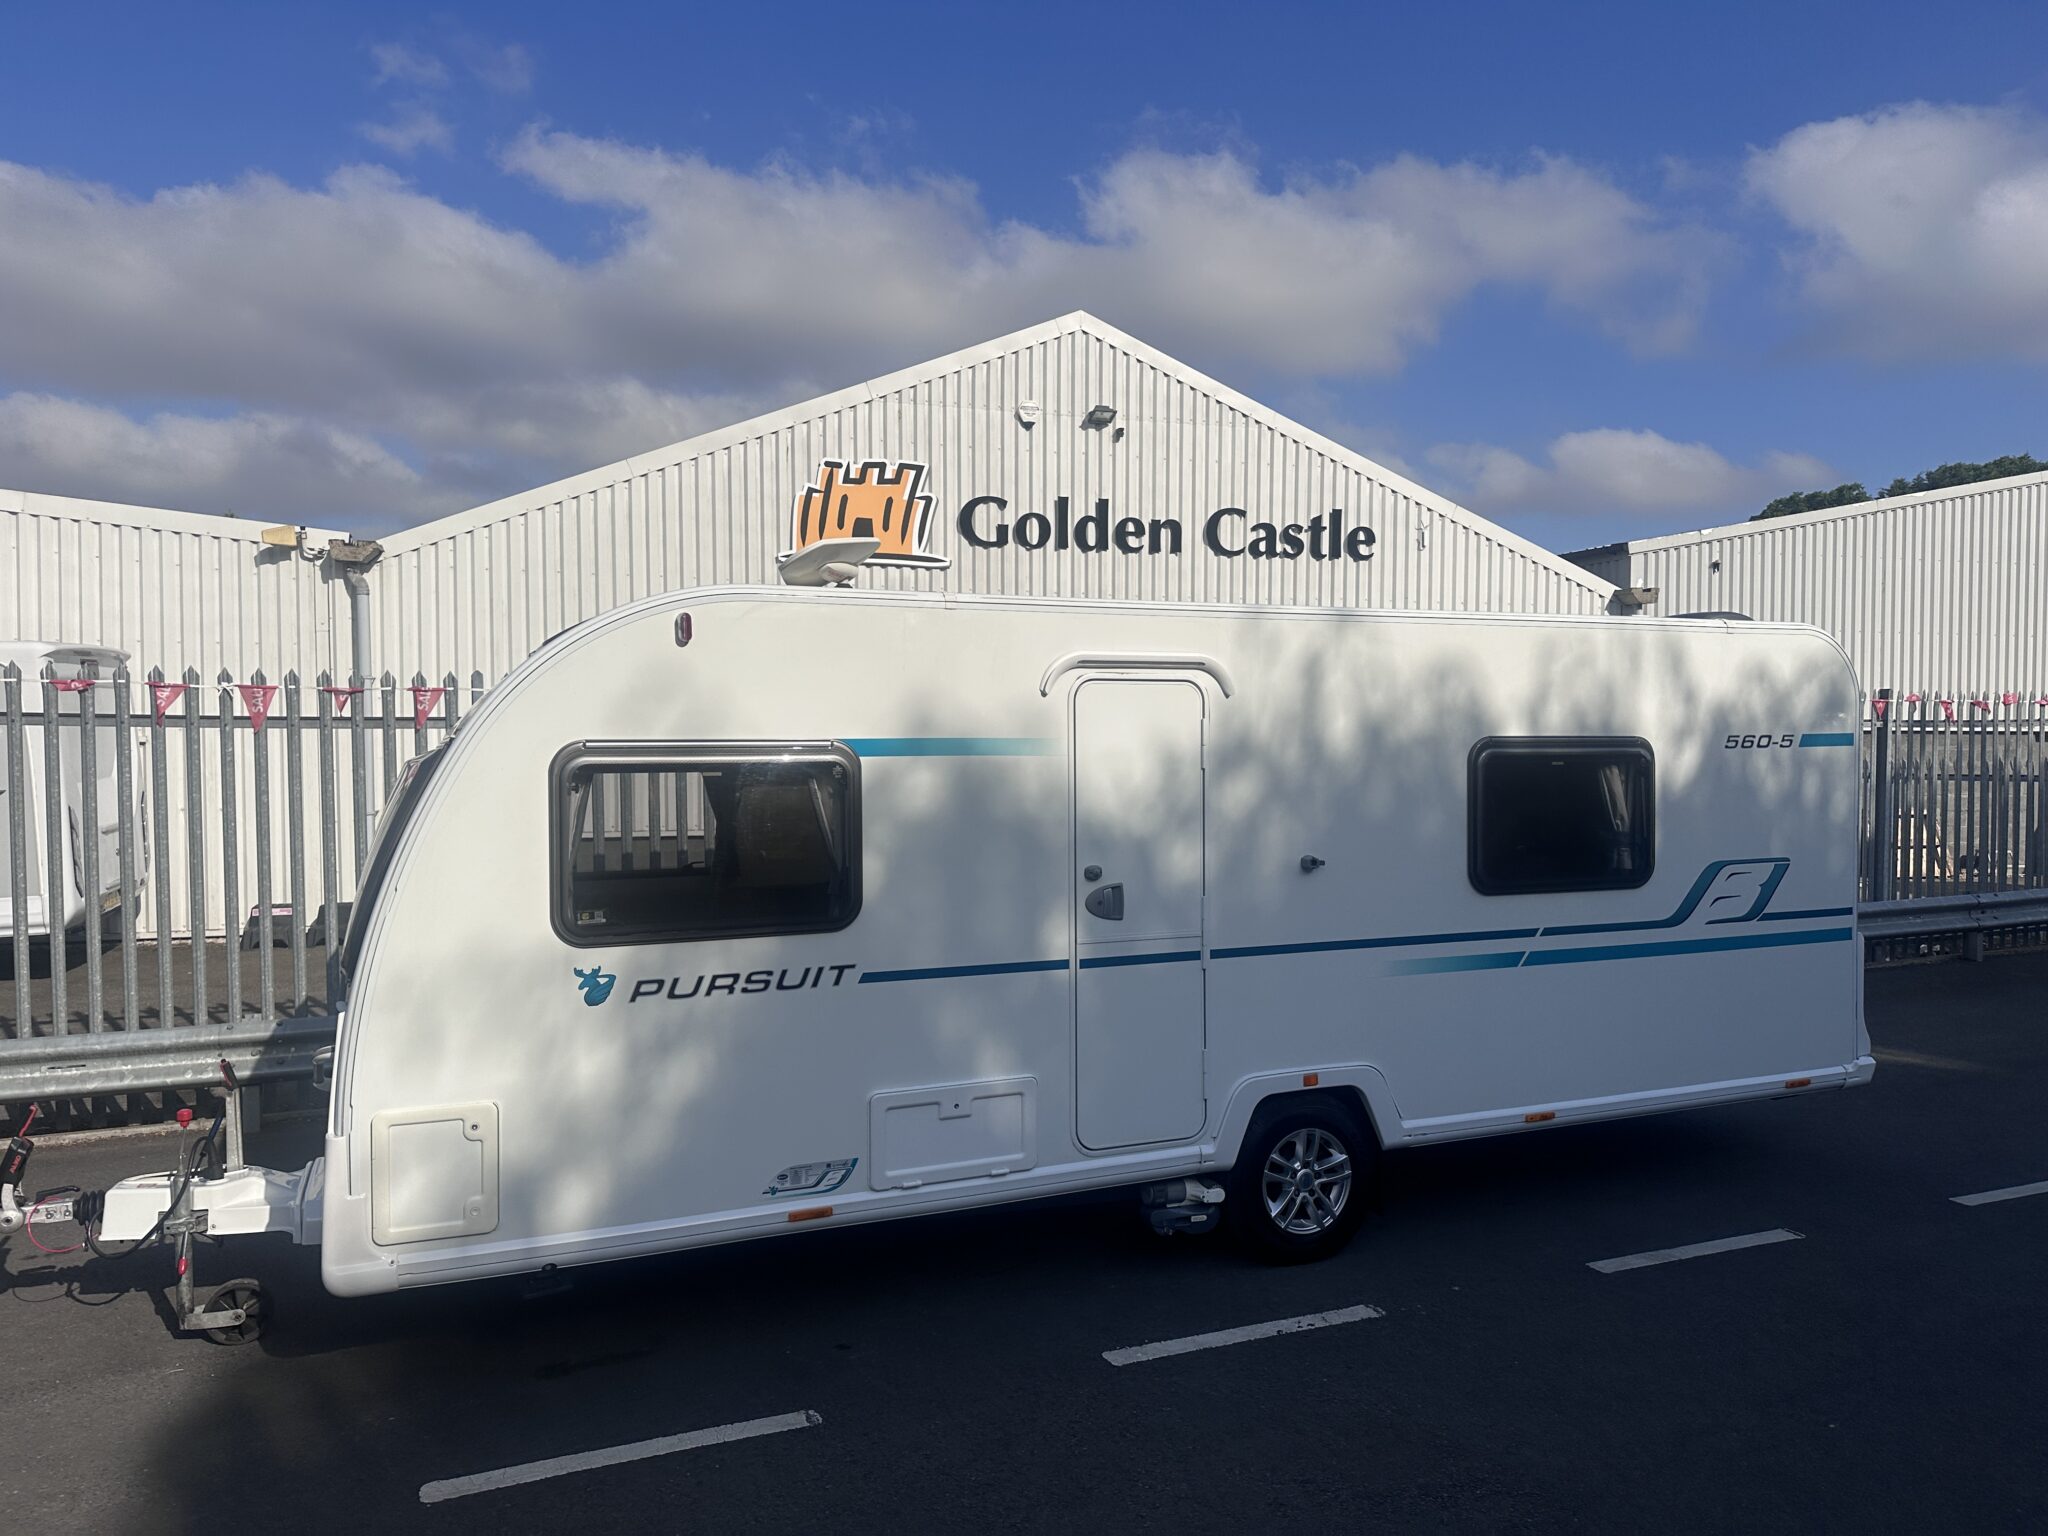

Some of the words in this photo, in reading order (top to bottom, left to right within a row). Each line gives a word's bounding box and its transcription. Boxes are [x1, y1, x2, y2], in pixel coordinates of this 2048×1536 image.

[958, 495, 1183, 556] Golden
[1205, 507, 1377, 563] Castle
[251, 688, 264, 713] SAL
[1724, 734, 1796, 749] 560-5
[628, 963, 857, 1004] PURSUIT
